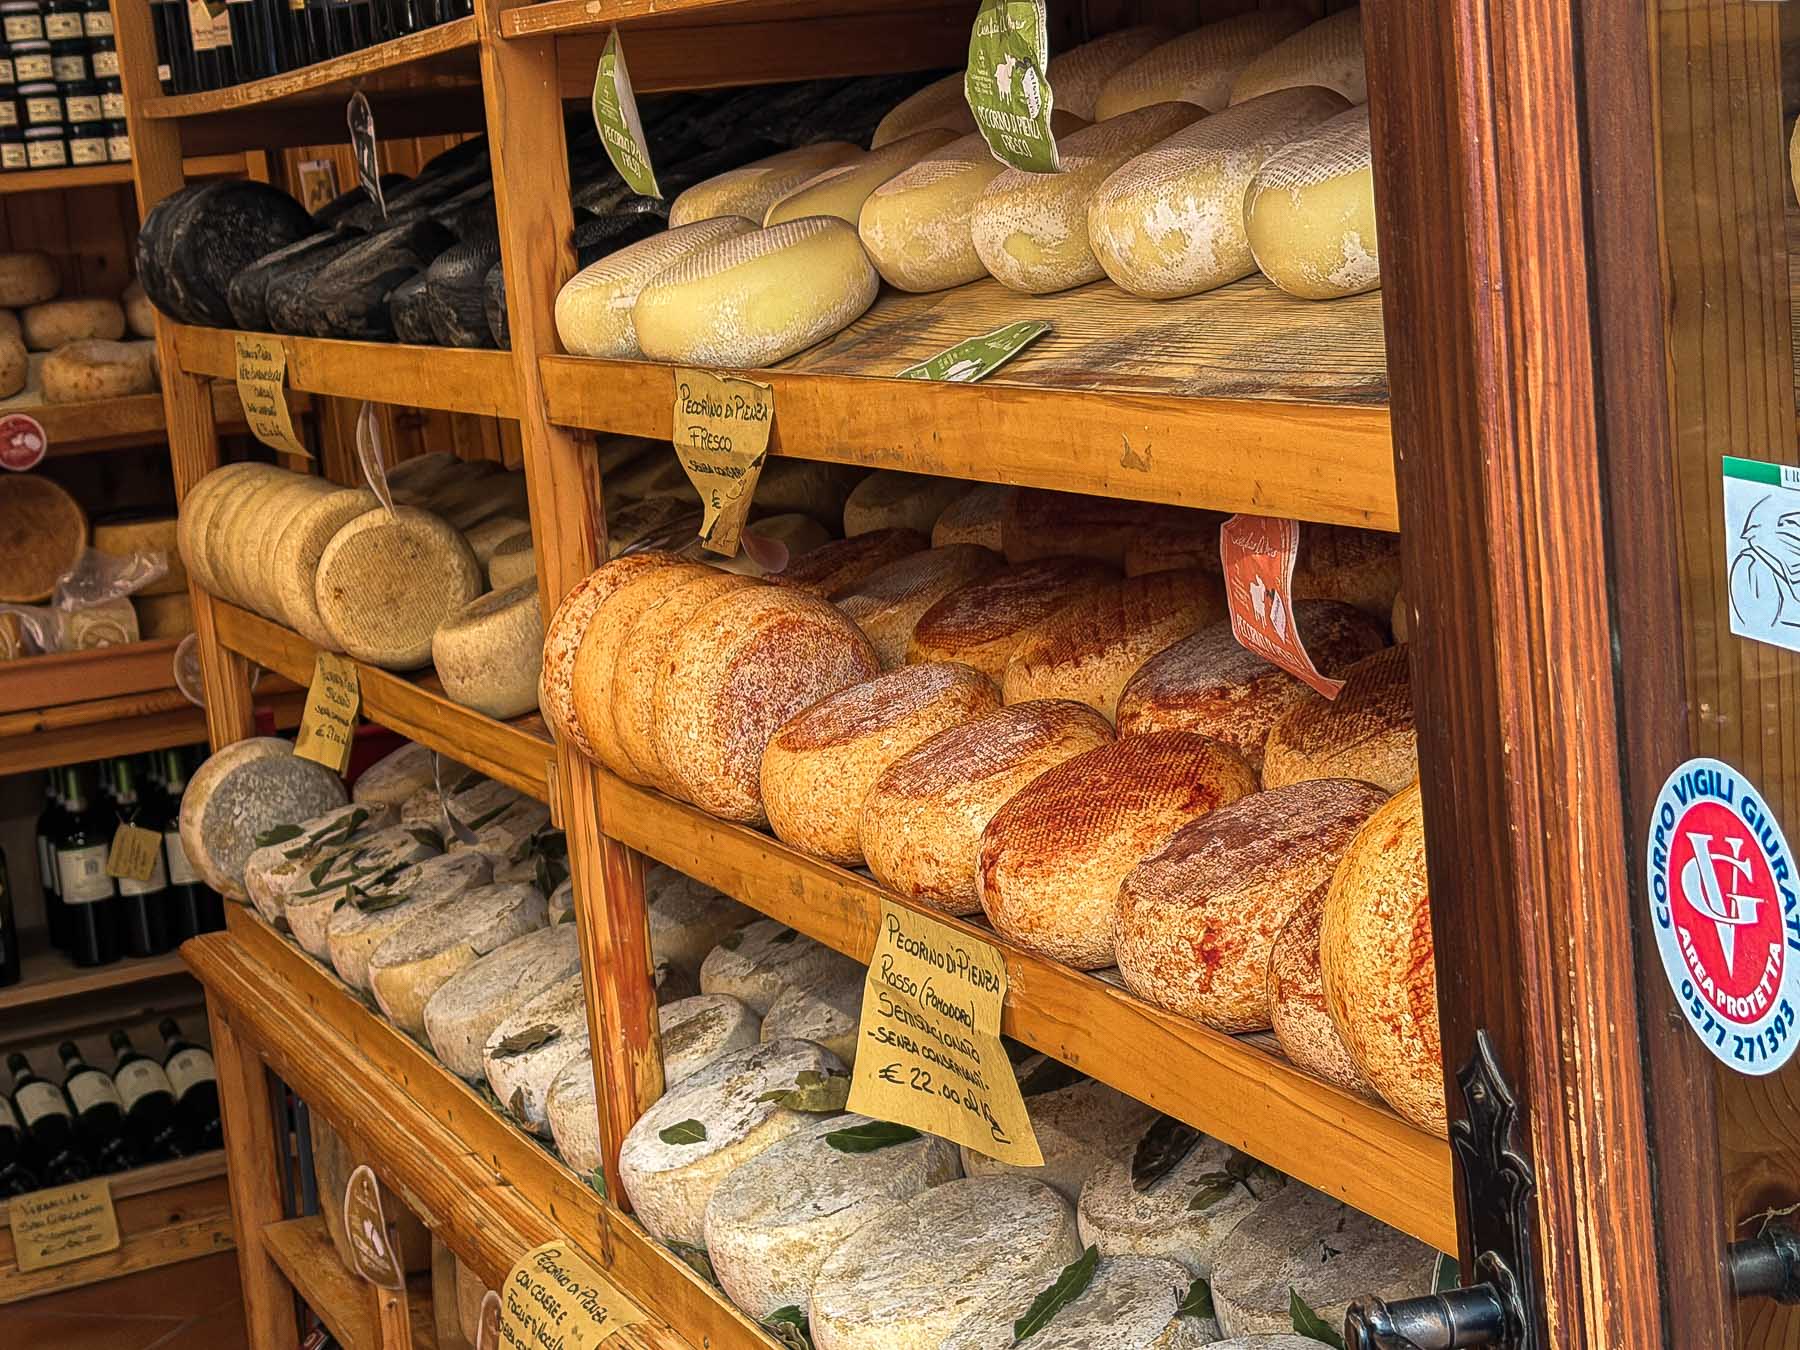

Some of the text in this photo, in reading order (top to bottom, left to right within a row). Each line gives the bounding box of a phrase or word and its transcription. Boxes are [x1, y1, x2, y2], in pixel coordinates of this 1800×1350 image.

[680, 383, 723, 418] PECORINO
[733, 395, 768, 421] PIENZA
[688, 426, 733, 452] FRESCO
[1653, 802, 1675, 929] CORPO
[1672, 768, 1734, 806] VIGILI
[881, 953, 918, 997] ROSSO
[886, 913, 1000, 994] PECORINO DI PIENZA
[1678, 925, 1781, 1018] AREA PROTETTA
[1681, 979, 1795, 1062] 0577 271393
[879, 1063, 905, 1085] €
[910, 1067, 961, 1104] 22.00
[515, 1270, 533, 1290] CON
[533, 1249, 571, 1287] PECORINO
[576, 1289, 607, 1325] PIENZA
